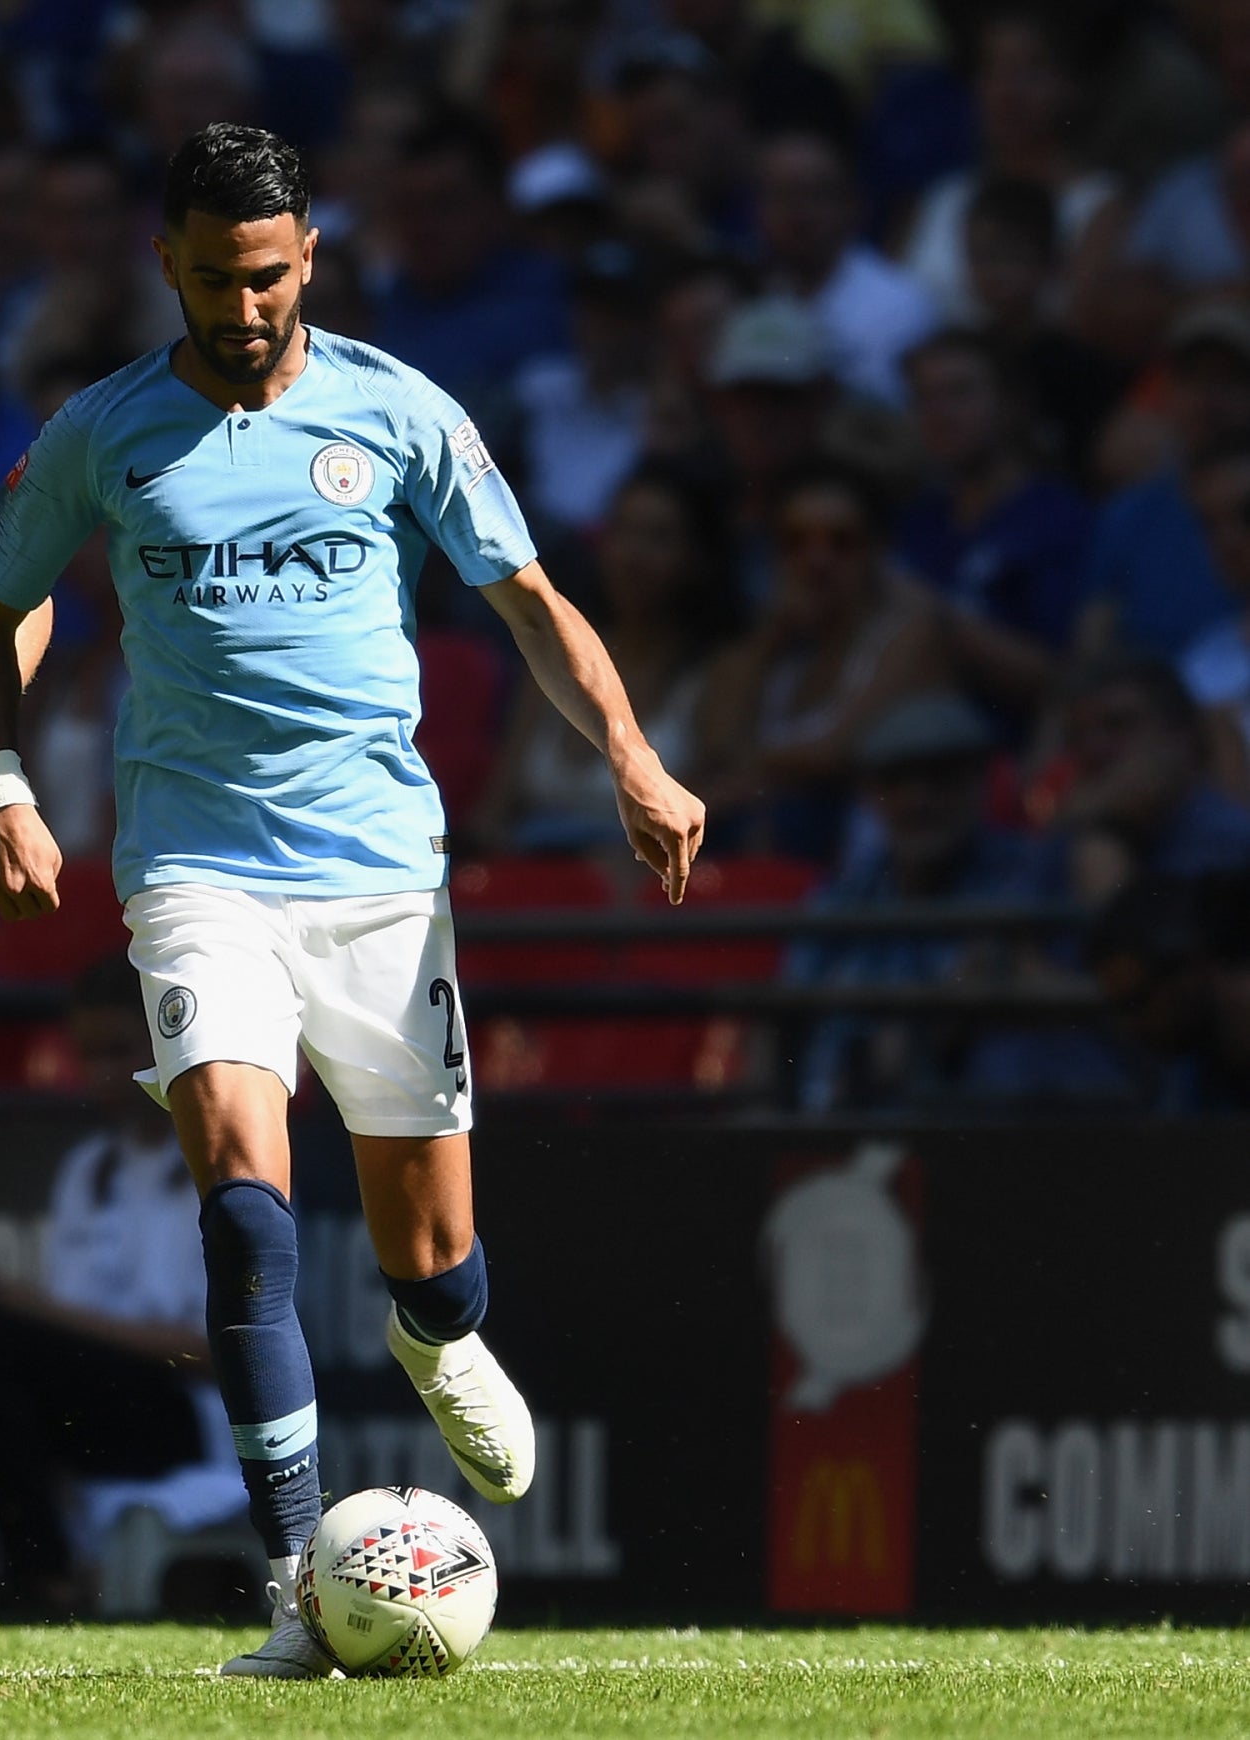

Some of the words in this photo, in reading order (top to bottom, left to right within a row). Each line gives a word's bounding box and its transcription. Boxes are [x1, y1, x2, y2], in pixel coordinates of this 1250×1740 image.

[318, 447, 368, 465] MANCHESTER
[138, 540, 367, 583] ETIHAD
[172, 583, 329, 605] AIRWAYS
[266, 1455, 310, 1482] CITY
